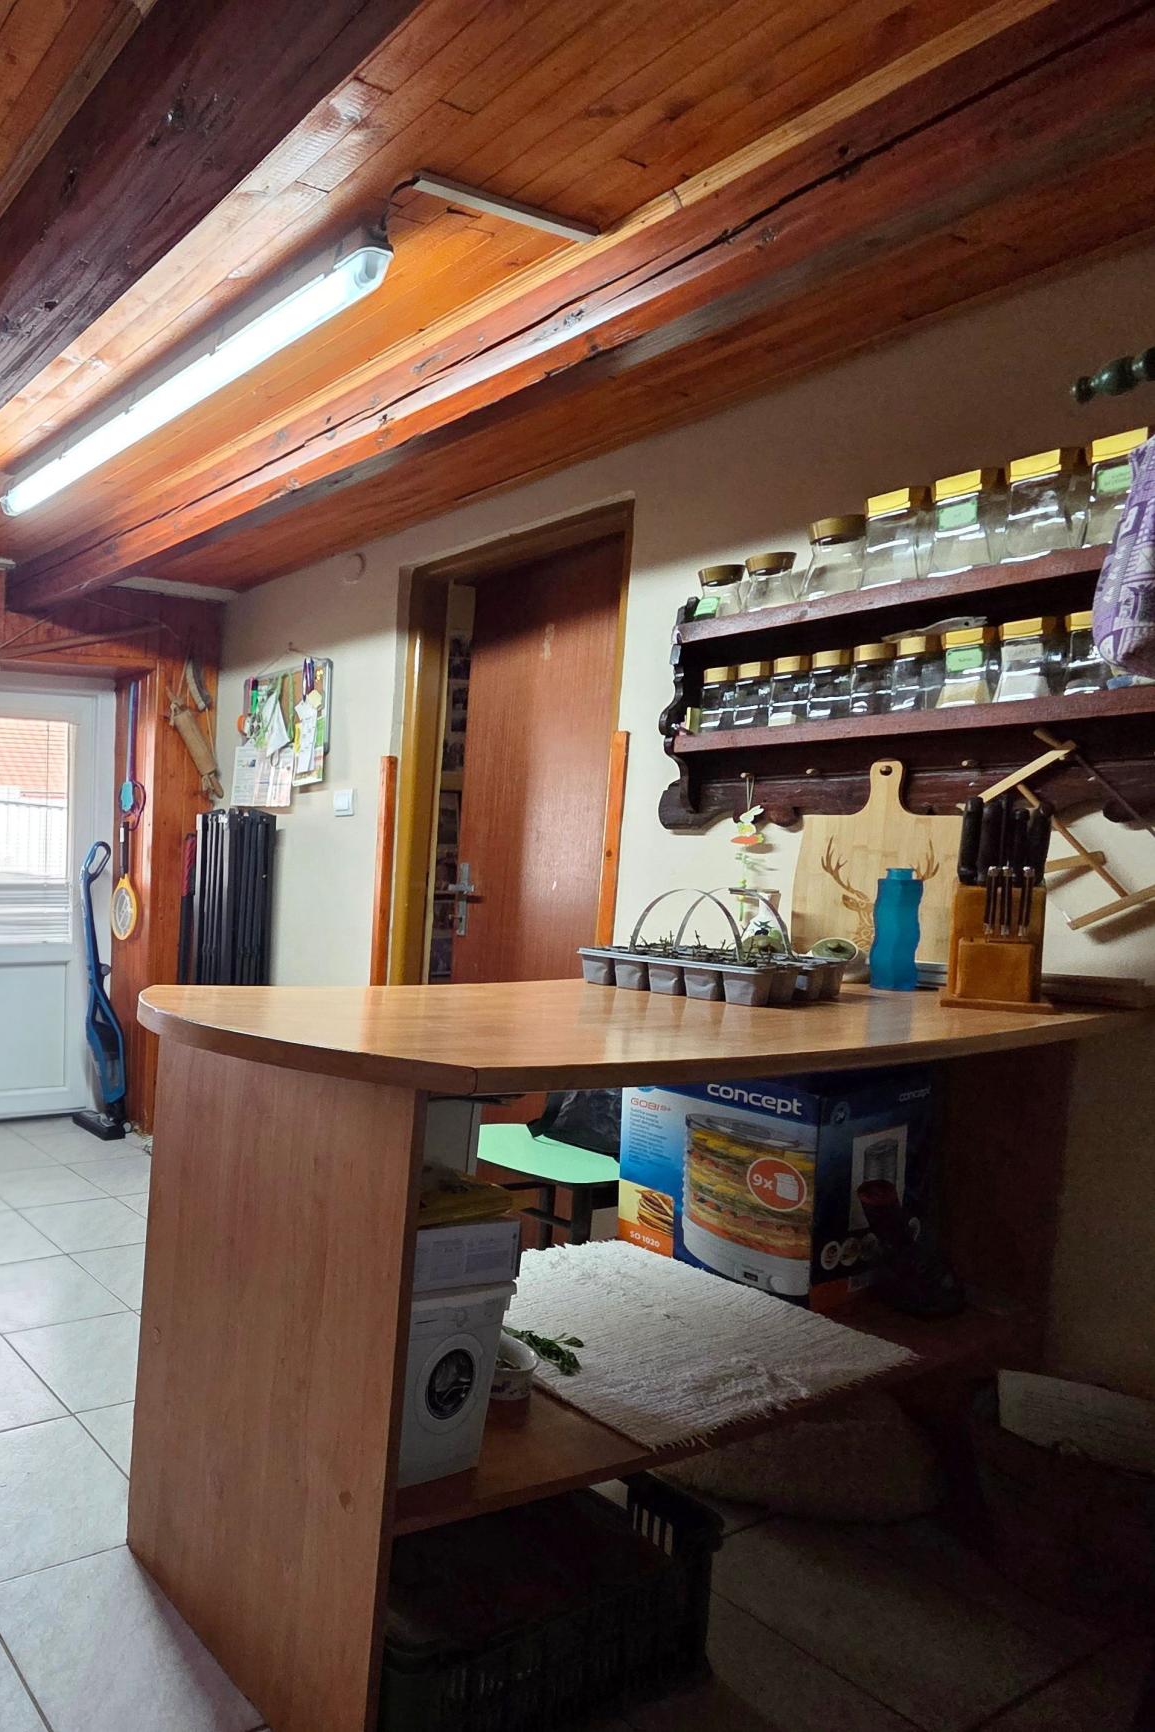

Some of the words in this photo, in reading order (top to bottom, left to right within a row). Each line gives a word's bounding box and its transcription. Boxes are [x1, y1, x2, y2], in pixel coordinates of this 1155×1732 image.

[707, 1083, 803, 1116] concept
[752, 1173, 773, 1190] 9x
[629, 1230, 641, 1240] SO
[642, 1234, 661, 1248] 1020
